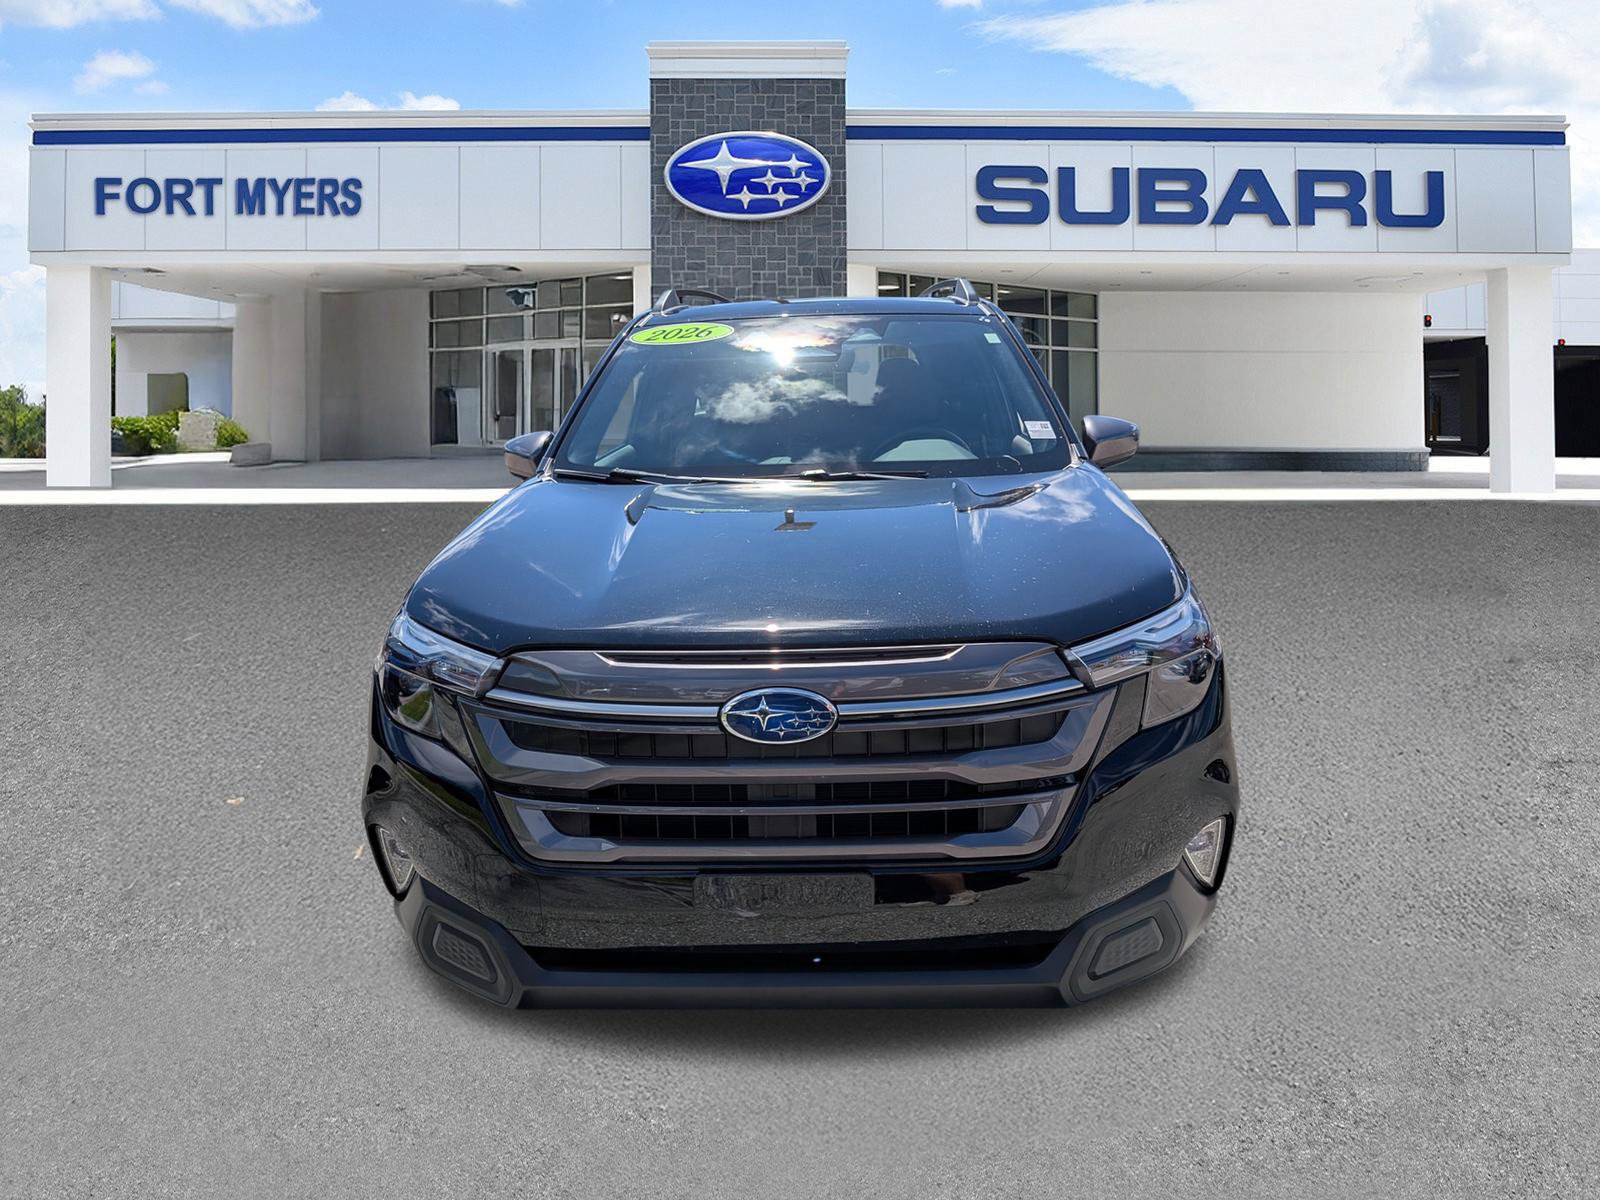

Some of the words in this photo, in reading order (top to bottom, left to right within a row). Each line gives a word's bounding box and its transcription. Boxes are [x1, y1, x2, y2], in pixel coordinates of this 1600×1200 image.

[95, 177, 222, 216] FORT
[234, 177, 363, 217] MYERS
[975, 165, 1445, 228] SUBARU
[645, 326, 716, 341] 2026
